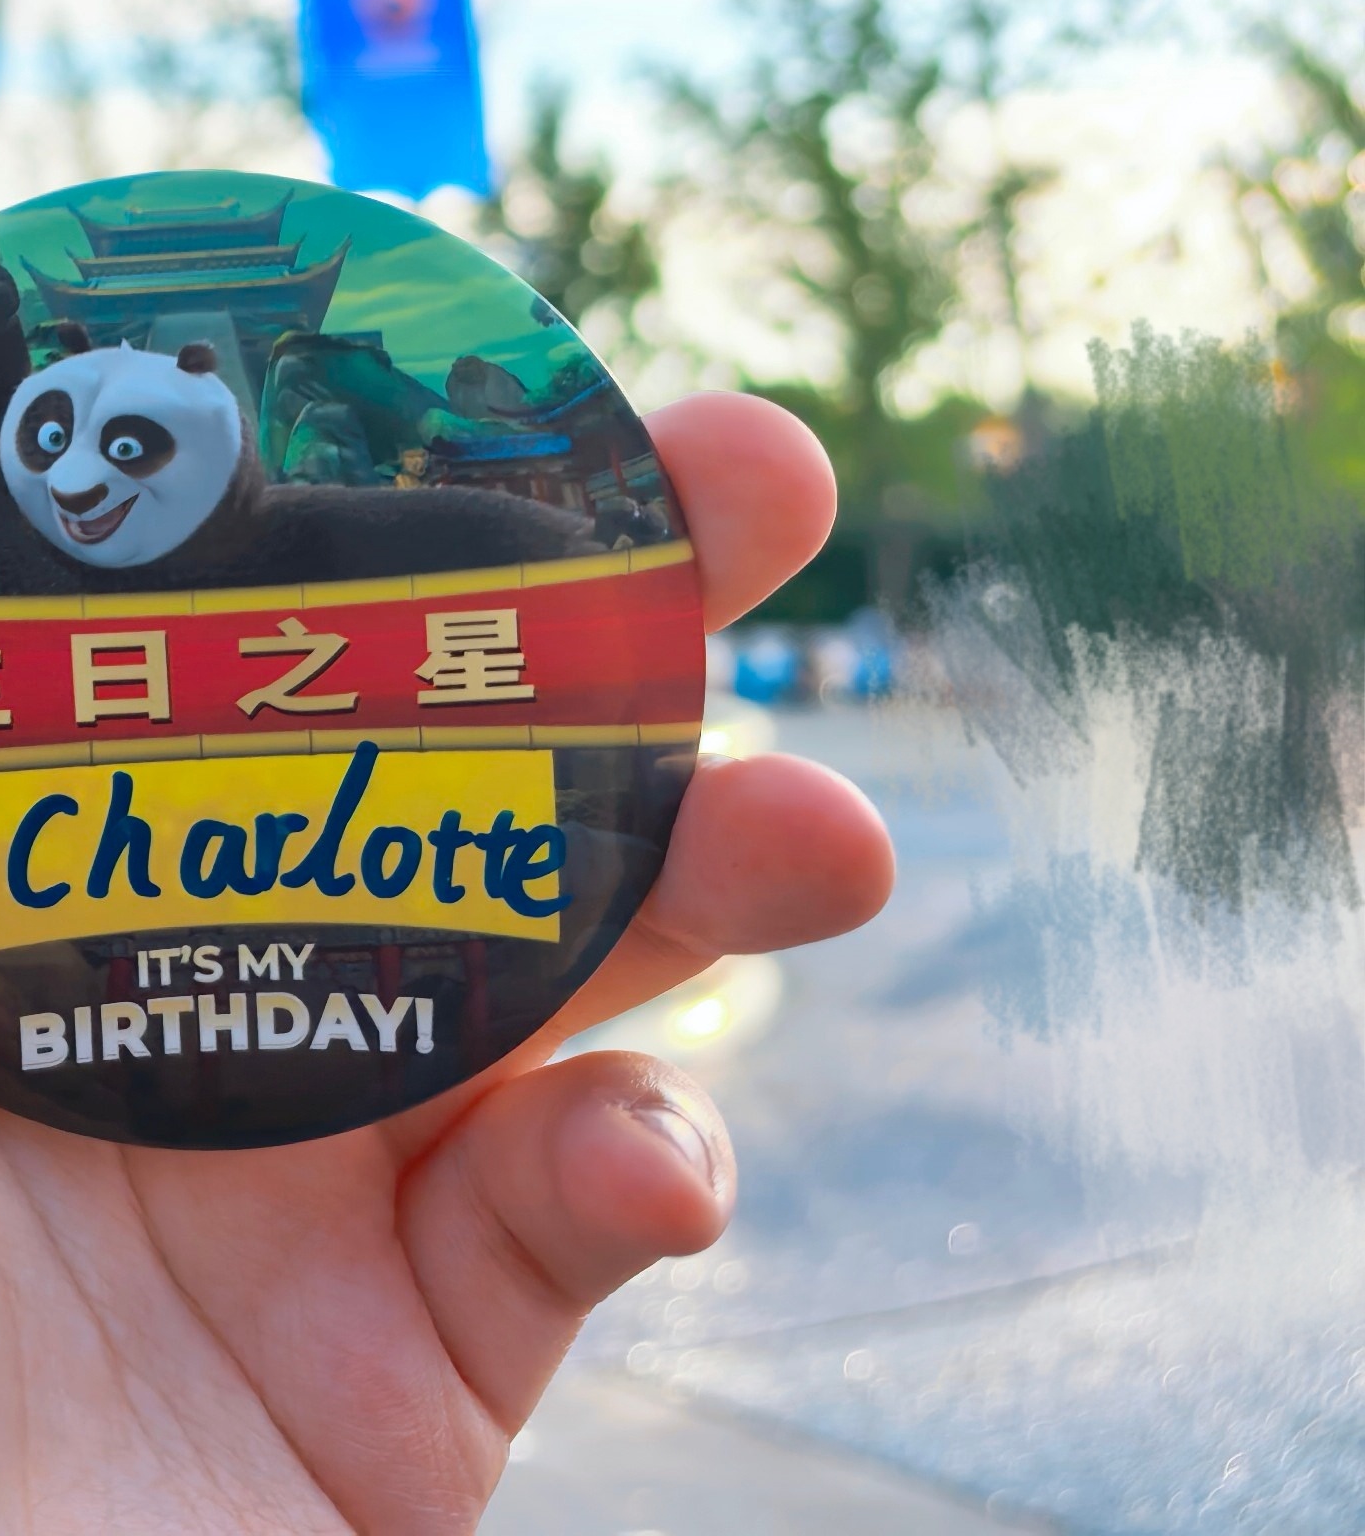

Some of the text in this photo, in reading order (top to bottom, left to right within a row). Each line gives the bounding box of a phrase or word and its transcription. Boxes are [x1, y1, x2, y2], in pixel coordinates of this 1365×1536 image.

[6, 740, 572, 915] Charlotte
[137, 942, 315, 989] IT'S MY
[19, 992, 436, 1071] BIRTHDAY!
